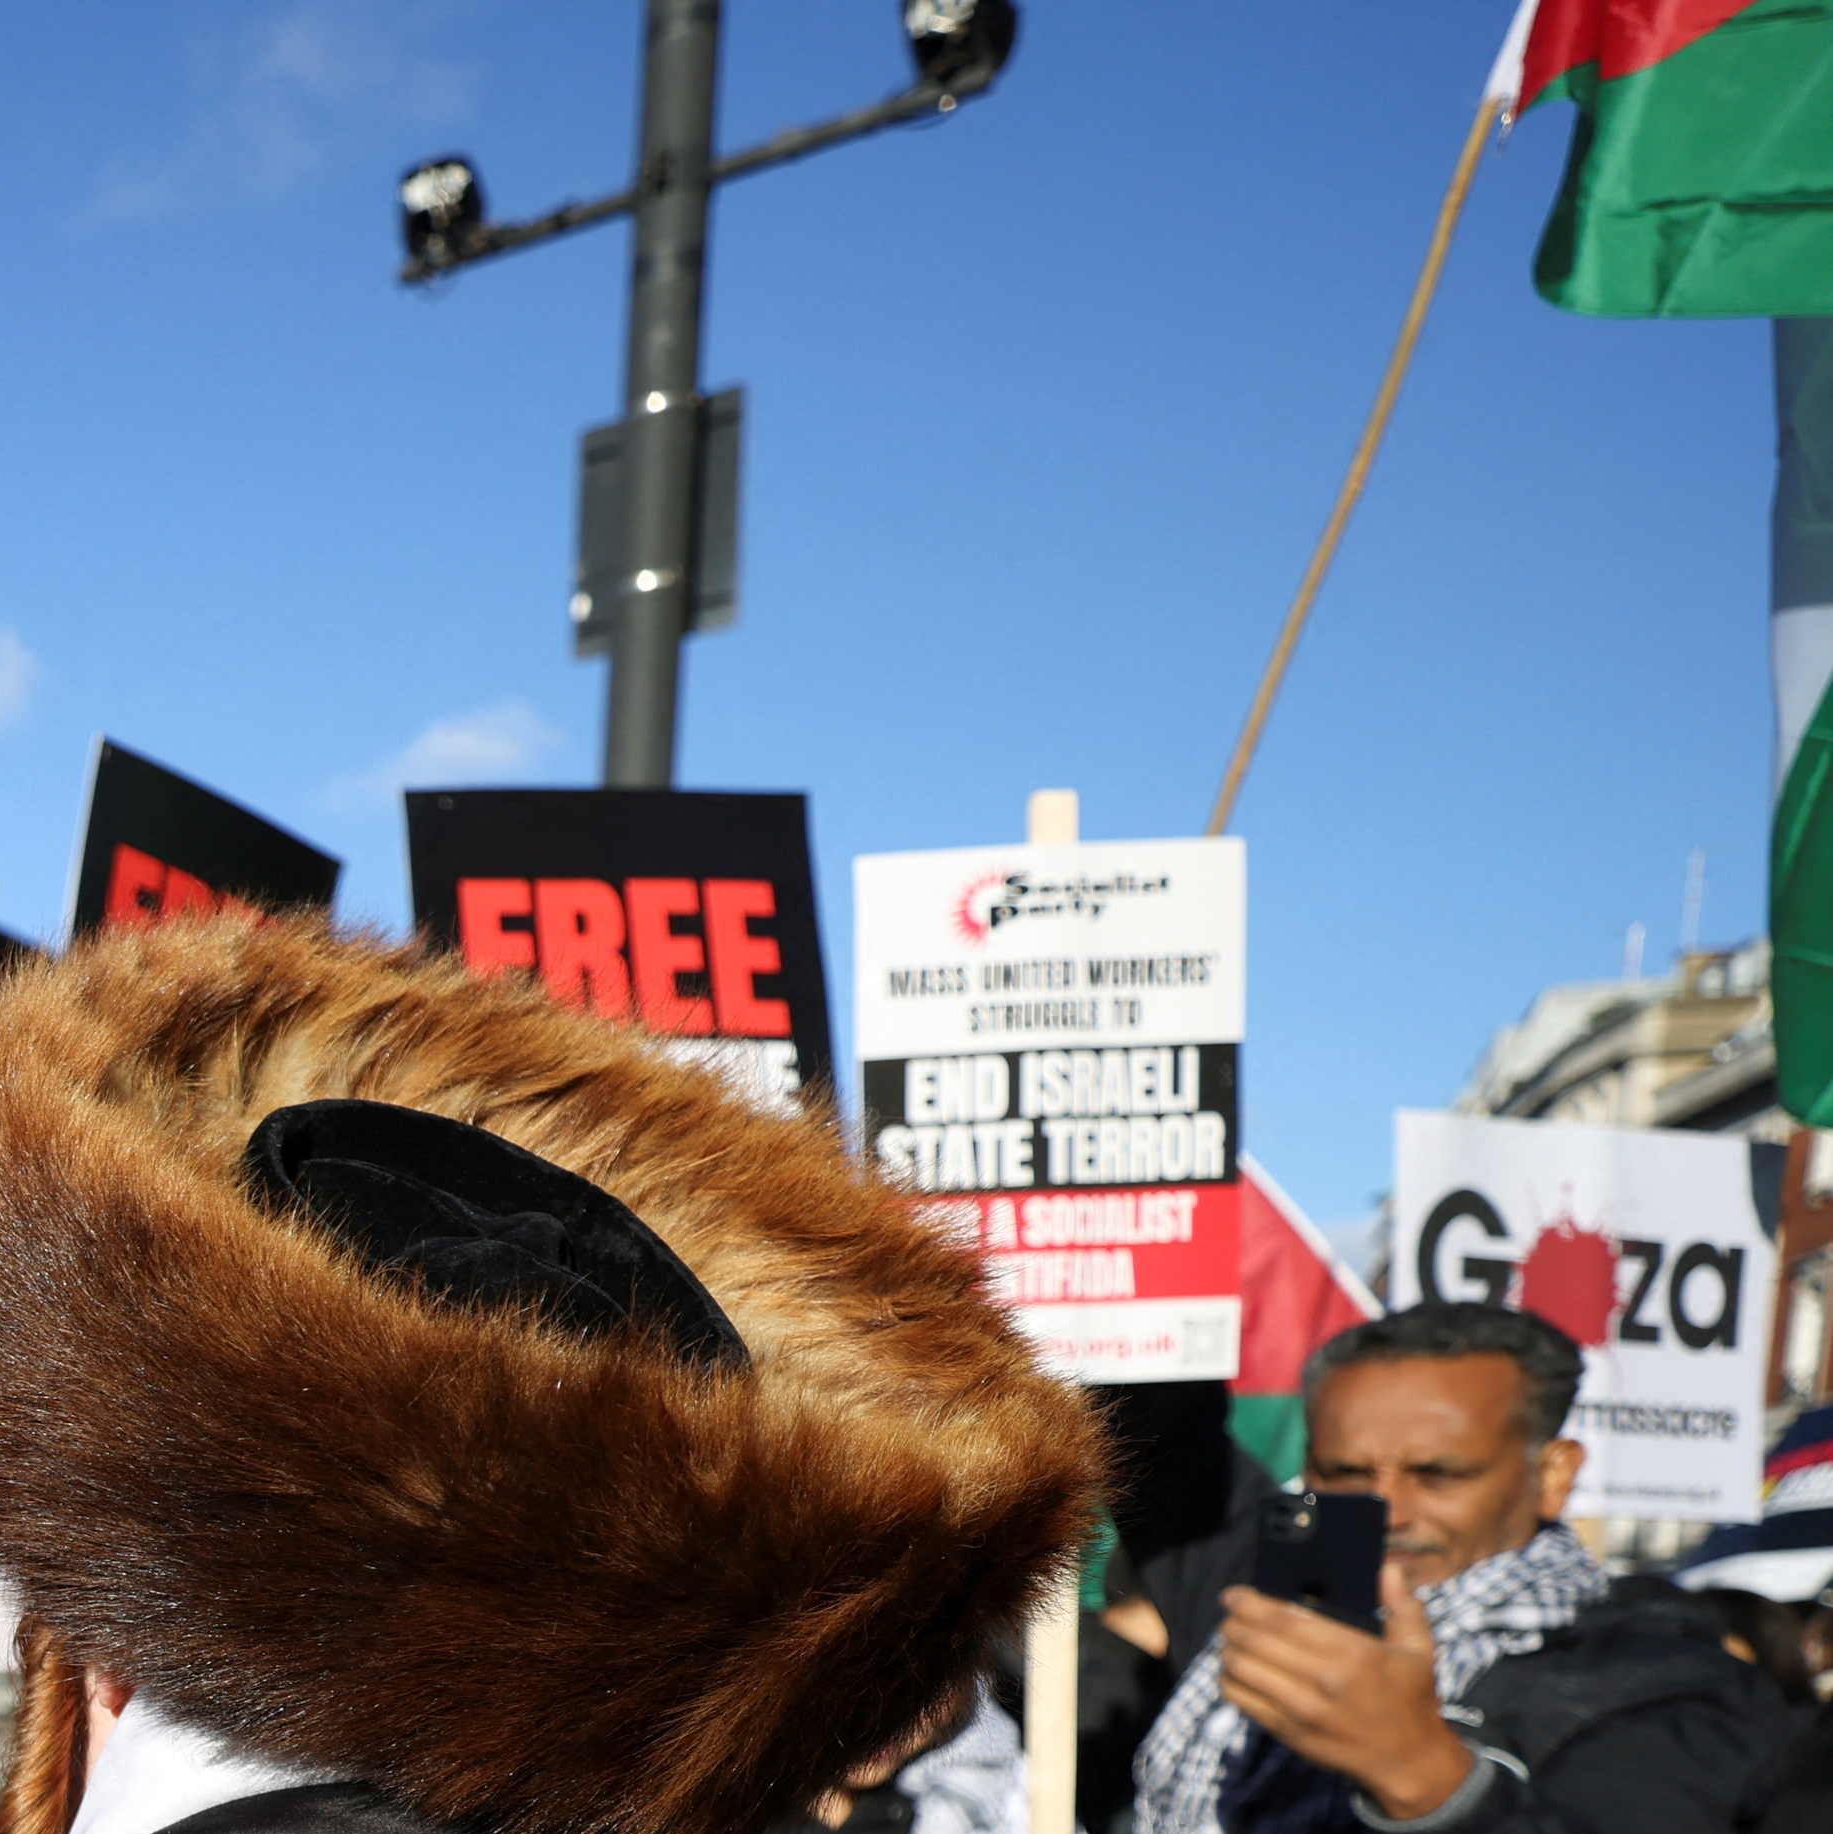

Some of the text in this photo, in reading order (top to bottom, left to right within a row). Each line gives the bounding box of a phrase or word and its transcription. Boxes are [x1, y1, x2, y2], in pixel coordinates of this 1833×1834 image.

[457, 877, 793, 1038] FREE
[888, 964, 969, 998] MASS
[982, 960, 1077, 990] UNITED
[969, 998, 1145, 1034] STRUGGLE TO
[904, 1046, 1200, 1126] END ISRAELI
[877, 1110, 1227, 1192] STATE TERROR
[984, 1196, 1019, 1250] A
[1020, 1190, 1199, 1248] SOCIALIST
[1417, 1190, 1748, 1352] Gza
